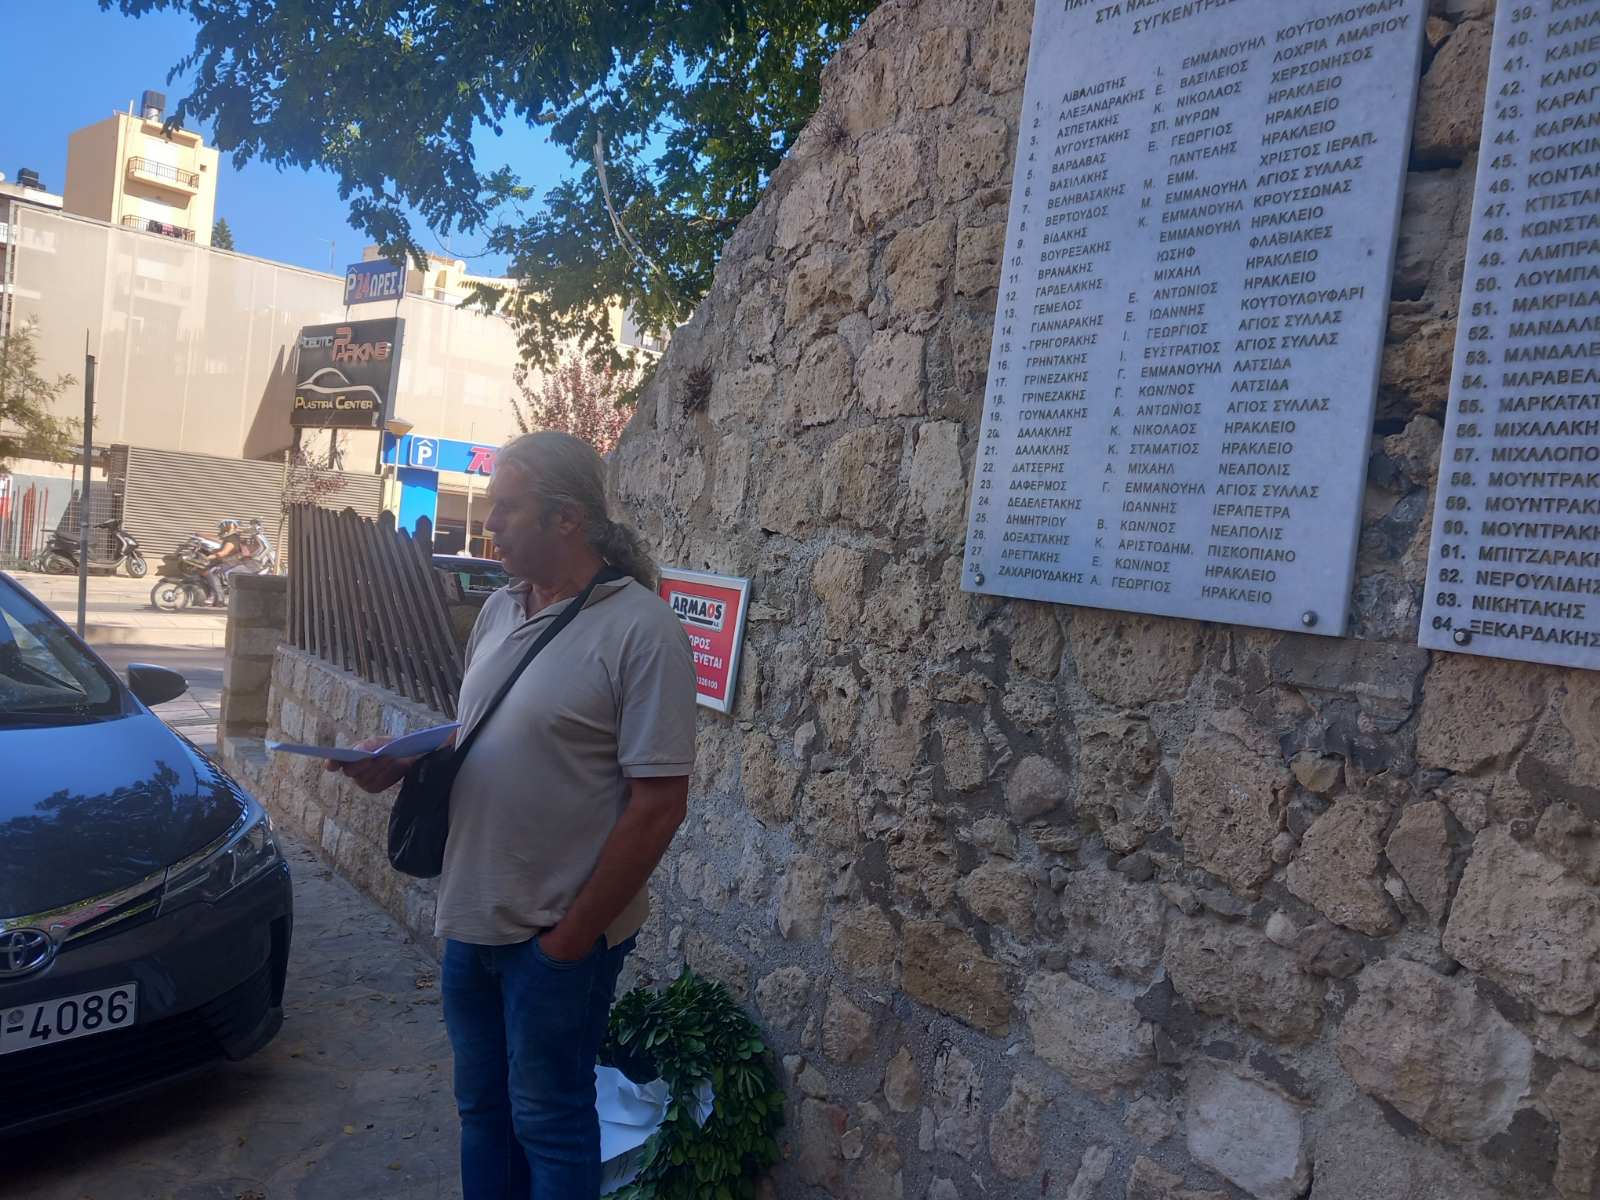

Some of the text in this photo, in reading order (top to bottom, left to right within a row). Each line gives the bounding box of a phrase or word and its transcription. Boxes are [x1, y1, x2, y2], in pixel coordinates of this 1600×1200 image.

[1095, 7, 1121, 24] ΣΤΑ
[1133, 0, 1237, 35] ΣΥΓΚΕΝΤΡ
[1511, 6, 1537, 24] 39.
[1506, 31, 1533, 48] 40.
[1058, 87, 1146, 123] ΑΛΕΞΑΝΔΡΑΚΗΣ
[1179, 58, 1249, 90] ΒΑΣΙΛΕΙΟΣ
[1335, 13, 1411, 47] ΑΜΑΡΙΟΥ
[1060, 75, 1128, 105] ΛΙΒΑΛΙΩΤΗΣ
[1181, 35, 1266, 71] ΕΜΜΑΝΟΥΗΛ
[1503, 55, 1530, 73] 41.
[1056, 45, 1374, 140] ΑΣΠΕΤΑΚΗΣ ΝΙΚΟΛΑΟΣ ΧΕΡΣΟΝΗΣΟΣ
[1499, 80, 1525, 97] 42.
[1053, 127, 1131, 158] ΑΥΓΟΥΣΤΑΚΗΣ
[1174, 105, 1221, 128] ΜΥΡΩΝ
[1266, 74, 1343, 105] ΗΡΑΚΛΕΙΟ
[1497, 104, 1524, 121] 43.
[1051, 96, 1341, 175] ΒΑΡΔΑΒΑΣ ΓΕΩΡΓΙΟΣ ΗΡΑΚΛΕΙΟ
[1494, 129, 1520, 145] 44.
[1048, 119, 1337, 193] ΒΑΣΙΛΑΚΗΣ ΠΑΝΤΕΛΗΣ ΗΡΑΚΛΕΙΟ
[1166, 168, 1199, 186] ΕΜΜ.
[1258, 142, 1322, 168] ΧΡΙΣΤΟΣ
[1490, 153, 1517, 170] 45.
[1044, 155, 1364, 228] ΒΕΡΤΟΥΔΟΣ ΕΜΜΑΝΟΥΗΛ ΑΓΙΟΣ ΣΥΛΛΑΣ
[1161, 199, 1245, 224] ΕΜΜΑΝΟΥΗΛ
[1252, 178, 1353, 209] ΚΡΟΥΣΣΩΝΑΣ
[1483, 201, 1510, 220] 47.
[1039, 205, 1325, 263] ΒΟΥΡΕΞΑΚΗΣ ΕΜΜΑΝΟΥΗΛ ΗΡΑΚΛΕΙΟ
[1037, 261, 1094, 281] ΒΡΑΝΑΚΗΣ
[1156, 245, 1197, 264] ΙΩΣΗΦ
[1478, 251, 1506, 268] 49.
[1034, 248, 1319, 299] ΓΑΡΔΕΛΑΚΗΣ ΜΙΧΑΗΛ ΗΡΑΚΛΕΙΟ
[1475, 276, 1501, 293] 50.
[1032, 269, 1317, 316] ΓΕΜΕΛΟΣ ΑΝΤΩΝΙΟΣ ΗΡΑΚΛΕΙΟ
[1030, 285, 1365, 334] ΓΙΑΝΝΑΡΑΚΗΣ ΙΩΑΝΝΗΣ ΚΟΥΤΟΥΛΟΥΦΑΡΙ
[1470, 301, 1498, 317] 51.
[1028, 309, 1343, 353] ΓΡΗΓΟΡΑΚΗΣ ΓΕΩΡΓΙΟΣ ΑΓΙΟΣ ΣΥΛΛΑΣ
[1468, 325, 1494, 341] 52.
[1143, 340, 1222, 360] ΕΥΣΤΡΑΤΙΟΣ
[1234, 336, 1278, 353] ΑΓΙΟΣ
[1280, 331, 1340, 350] ΣΥΛΛΑΣ
[1023, 356, 1292, 386] ΓΡΙΝΕΖΑΚΗΣ ΕΜΜΑΝΟΥΗΛ ΛΑΤΣΙΔΑ
[1501, 367, 1600, 389] ΜΑΡΑΒΕΛ
[335, 396, 373, 409] CENTER
[1021, 377, 1290, 404] ΓΡΙΝΕΖΑΚΗΣ ΚΩΝ/ΝΟΣ ΛΑΤΣΙΔΑ
[1018, 397, 1331, 422] ΓΟΥΝΑΛΑΚΗΣ ΑΝΤΩΝΙΟΣ ΑΓΙΟΣ ΣΥΛΛΑΣ
[1016, 420, 1297, 441] ΔΑΛΑΚΛΗΣ ΝΙΚΟΛΑΟΣ ΗΡΑΚΛΕΙΟ
[1493, 418, 1600, 439] ΜΙΧΑΛΑΚΗ
[1014, 441, 1294, 457] ΔΑΛΑΚΛΗΣ ΣΤΑΜΑΤΙΟΣ ΗΡΑΚΛΕΙΟ
[1490, 445, 1600, 465] ΜΙΧΑΛΟΠΟ
[1127, 462, 1175, 475] ΜΙΧΑΗΛ
[1218, 462, 1291, 477] ΝΕΑΠΟΛΙΣ
[1487, 469, 1600, 489] ΜΟΥΝΤΡΑΚ
[1008, 479, 1320, 499] ΔΑΦΕΡΜΟΣ ΕΜΜΑΝΟΥΗΛ ΑΓΙΟΣ ΣΥΛΛΑΣ
[1007, 496, 1291, 520] ΔΕΔΕΛΕΤΑΚΗΣ ΙΩΑΝΝΗΣ ΙΕΡΑΠΕΤΡΑ
[1484, 495, 1600, 516] ΜΟΥΝΤΡΑΚ
[1005, 512, 1284, 541] ΔΗΜΗΤΡΙΟΥ ΚΩΝ/ΝΟΣ ΝΕΑΠΟΛΙΣ
[1002, 530, 1297, 564] ΔΟΞΑΣΤΑΚΗΣ ΑΡΙΣΤΟΔΗΜ. ΠΙΣΚΟΠΙΑΝΟ
[1440, 543, 1466, 560] 61.
[1000, 547, 1277, 584] ΔΡΕΤΤΑΚΗΣ ΚΩΝ/ΝΟΣ ΗΡΑΚΛΕΙΟ
[1438, 568, 1464, 584] 62.
[997, 564, 1273, 605] ΖΑΧΑΡΙΟΥΔΑΚΗΣ ΓΕΩΡΓΙΟΣ ΗΡΑΚΛΕΙΟ
[672, 596, 722, 620] ARMAOS
[1436, 592, 1587, 621] 63. ΝΙΚΗΤΑΚΗΣ
[693, 651, 723, 669] ΕΥΕΤΑΙ
[0, 990, 128, 1041] -4086
